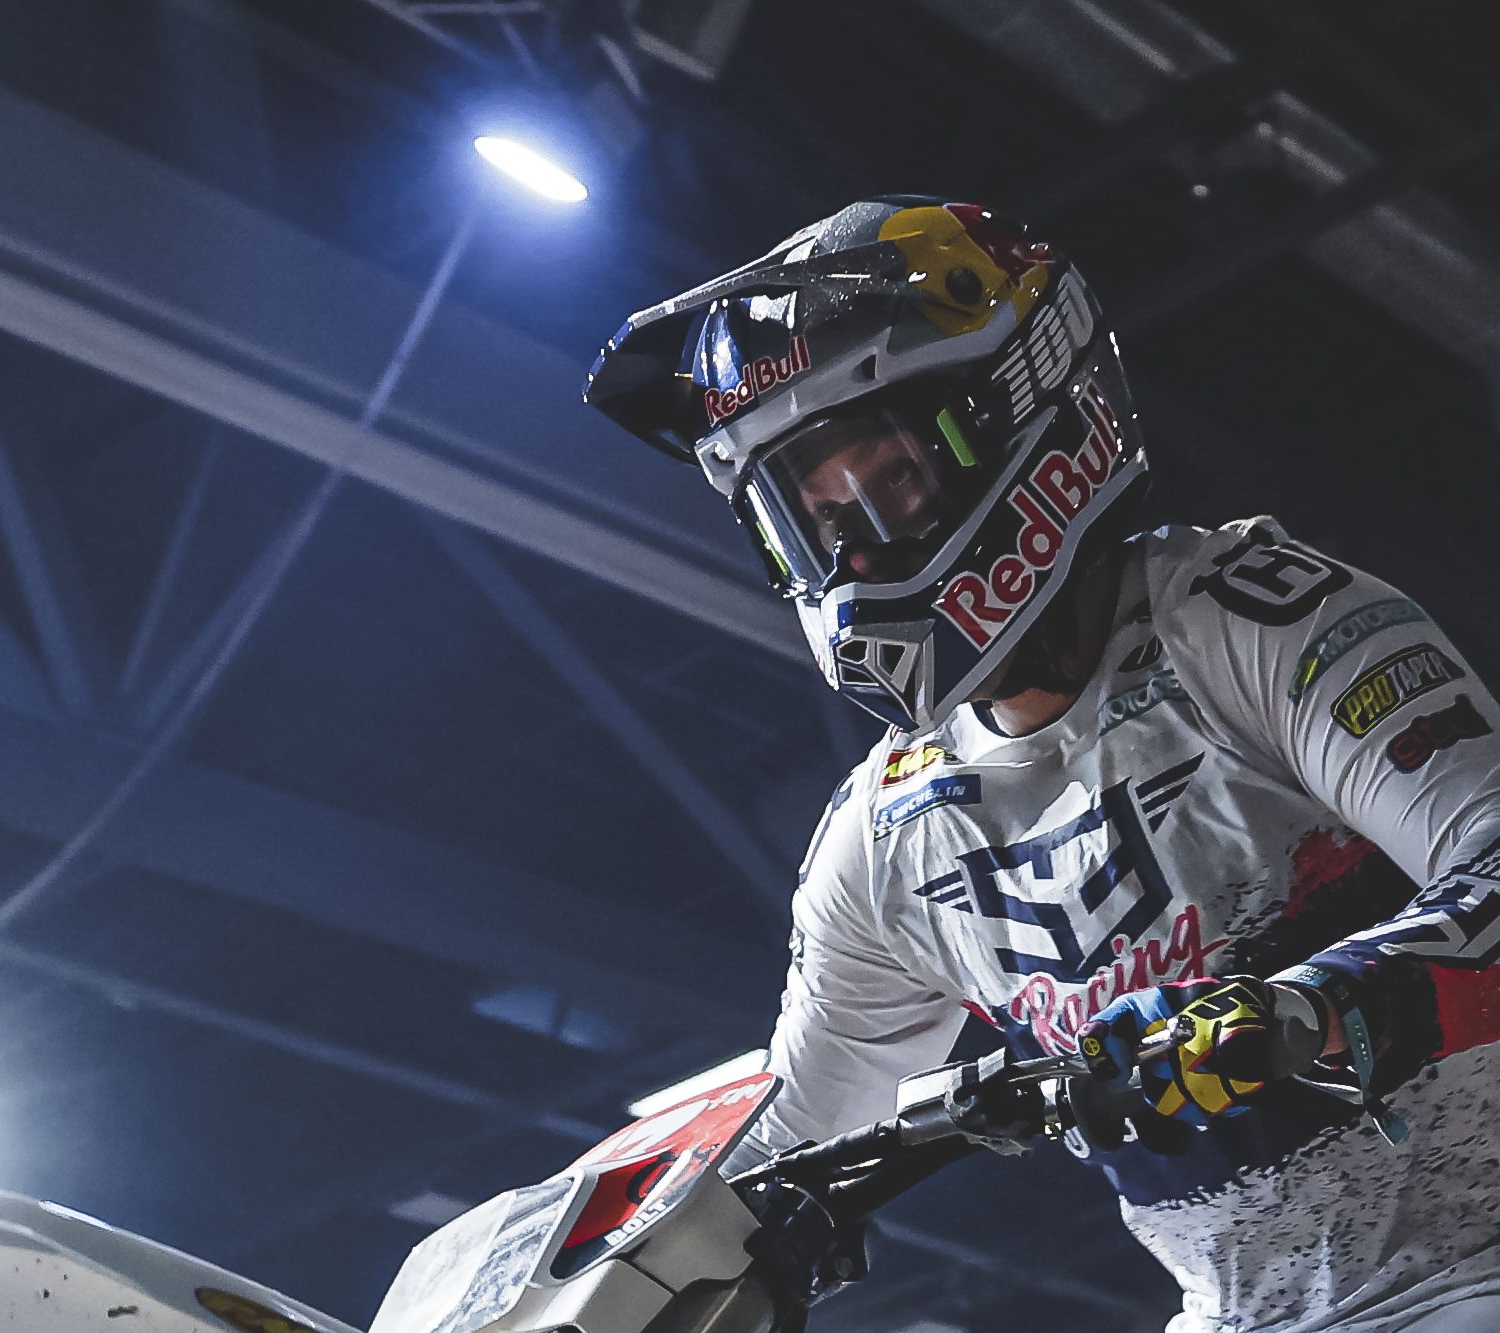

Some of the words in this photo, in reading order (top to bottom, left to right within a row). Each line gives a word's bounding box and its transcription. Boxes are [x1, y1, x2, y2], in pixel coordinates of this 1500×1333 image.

[705, 363, 754, 427] Red
[753, 335, 811, 394] Bull
[931, 485, 1066, 653] Red
[1029, 377, 1123, 522] Bull
[1011, 904, 1230, 1056] Racing
[603, 1198, 668, 1247] BOLT
